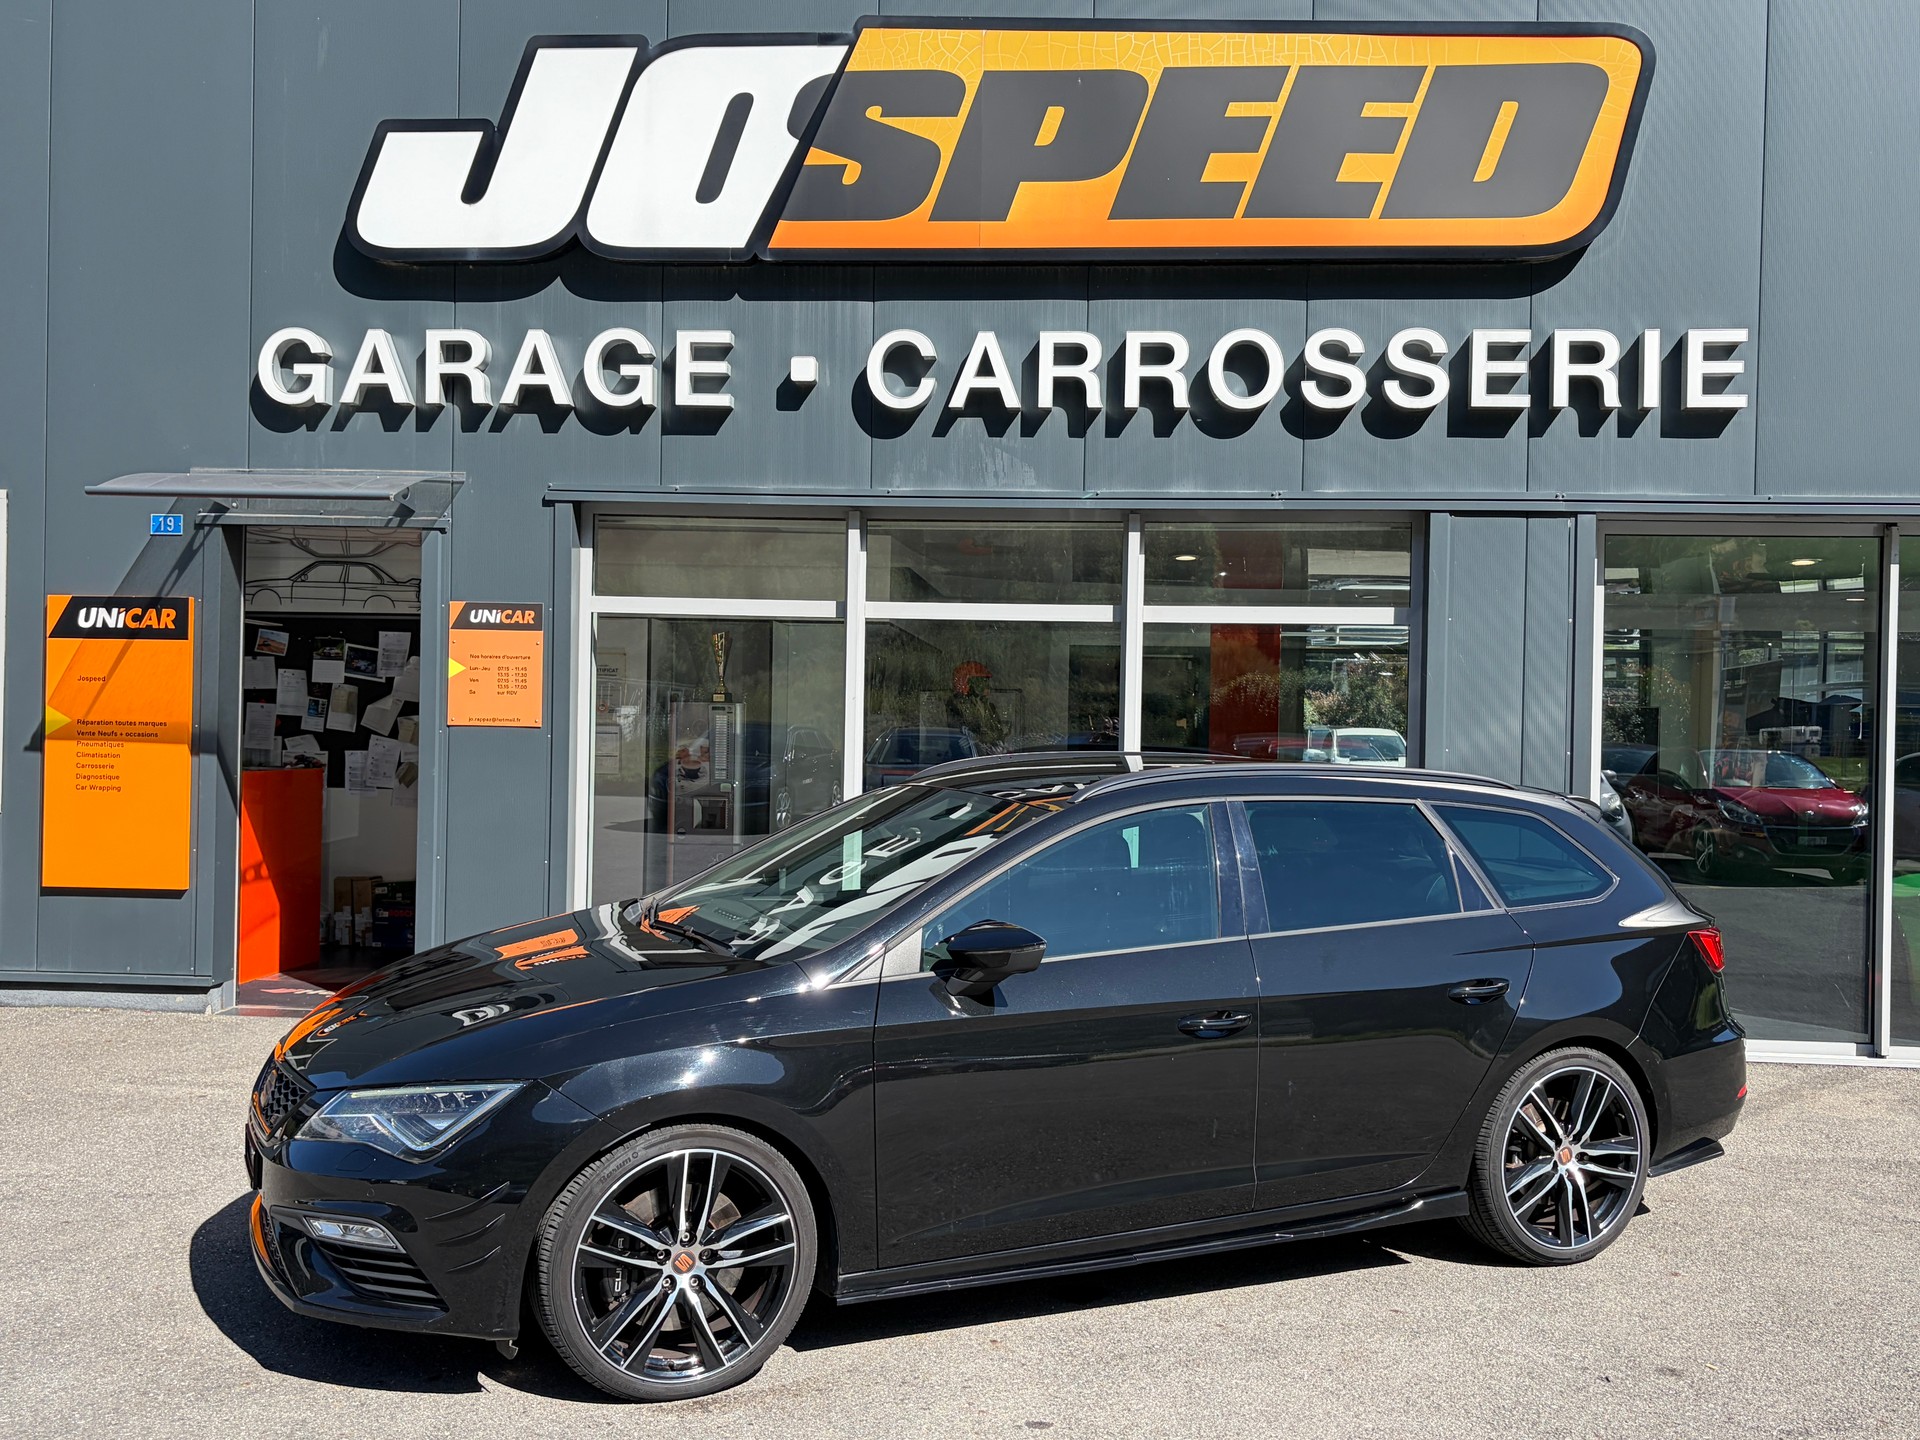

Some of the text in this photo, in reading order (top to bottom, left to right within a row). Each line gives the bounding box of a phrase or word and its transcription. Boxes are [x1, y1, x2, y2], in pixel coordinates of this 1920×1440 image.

[257, 326, 1749, 410] GARAGE CARROSSERIE
[159, 516, 175, 531] 19
[77, 674, 106, 684] Jospeed
[76, 718, 168, 729] Réparation toutes marques
[76, 729, 96, 738] Vente
[97, 730, 118, 738] Neufs
[125, 730, 159, 738] occasions
[76, 740, 125, 749] Pneumatiques
[76, 751, 121, 759] Climatisation
[75, 762, 115, 770] Carrosserie
[75, 773, 120, 782] Diagnostique
[75, 784, 122, 793] Car Wrapping
[614, 1237, 625, 1292] CUA
